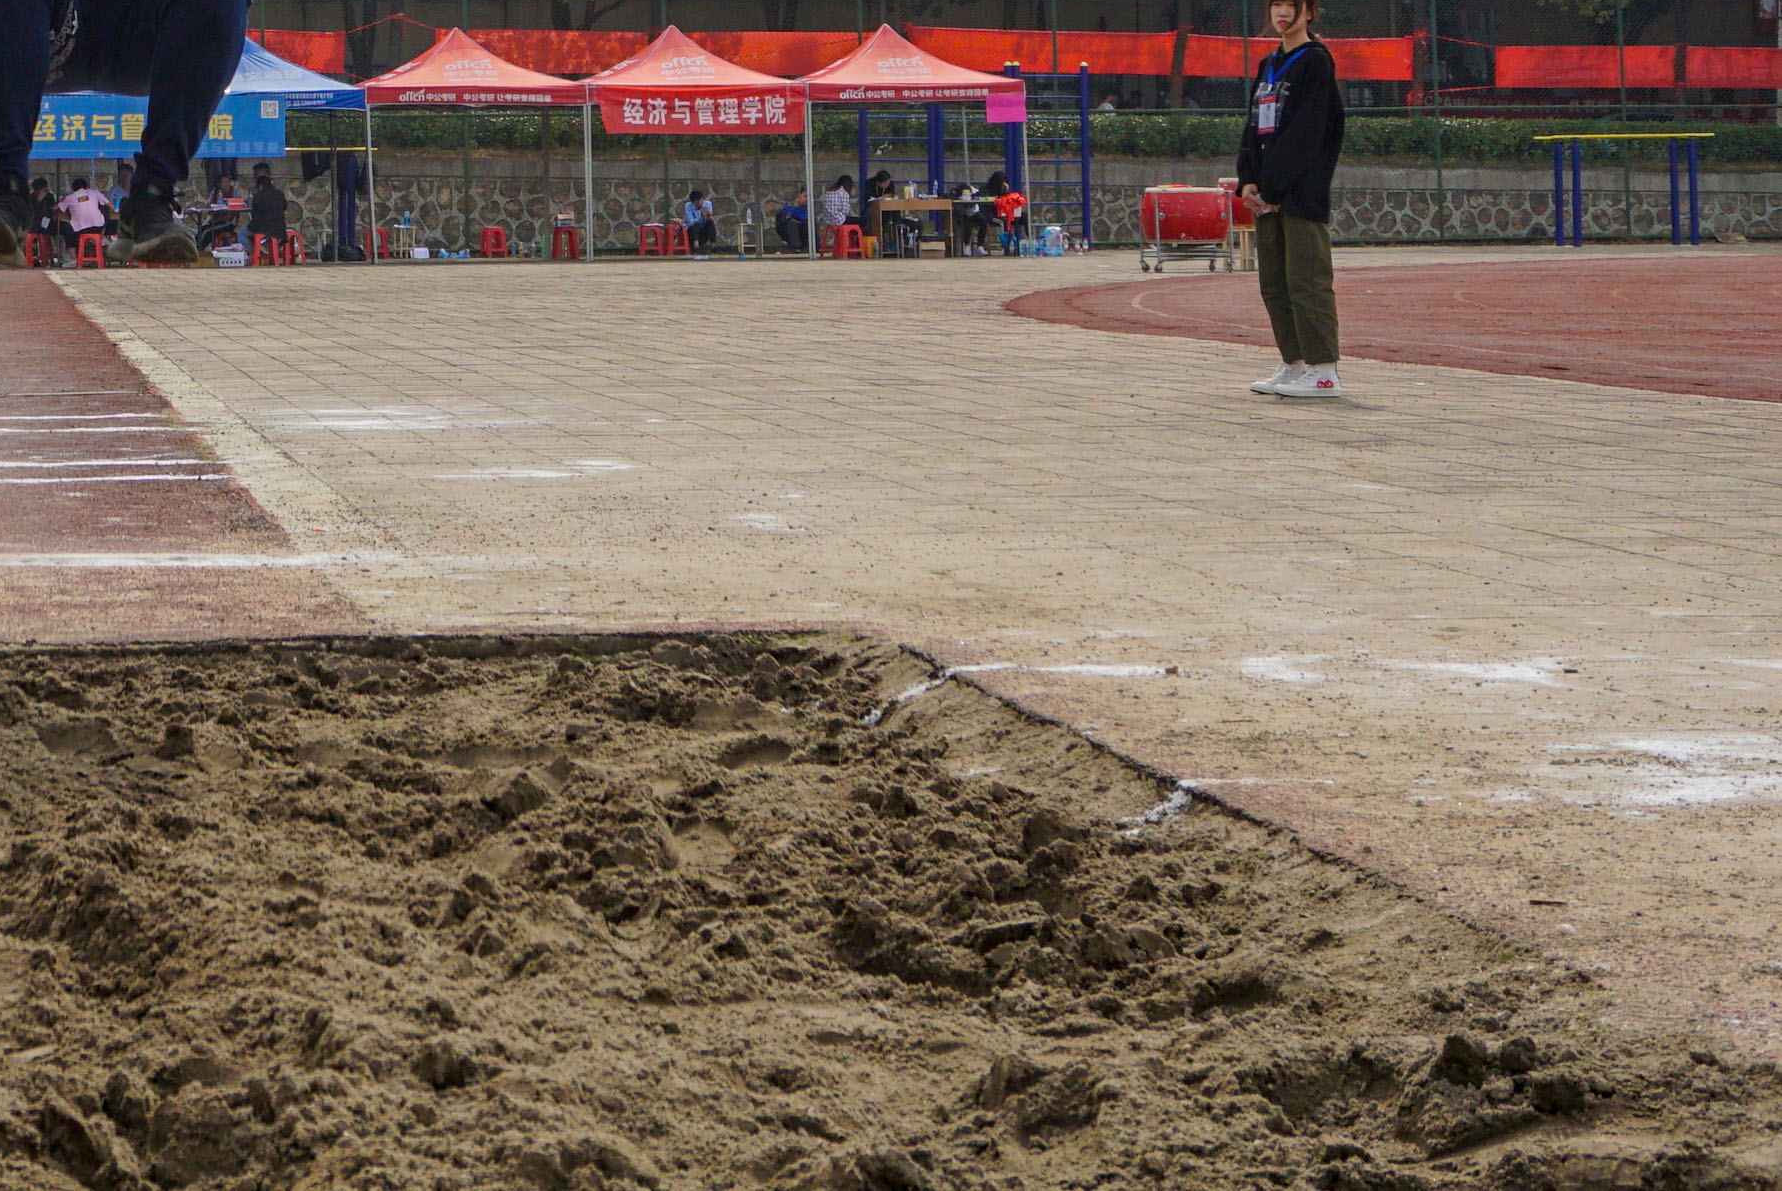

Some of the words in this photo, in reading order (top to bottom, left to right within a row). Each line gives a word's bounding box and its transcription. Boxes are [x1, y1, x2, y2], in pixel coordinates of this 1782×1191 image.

[398, 88, 426, 102] offcn
[839, 86, 865, 99] offcn
[865, 90, 896, 99] 中公考研
[902, 89, 933, 98] 中公考研
[622, 94, 787, 125] 经济与管理学院
